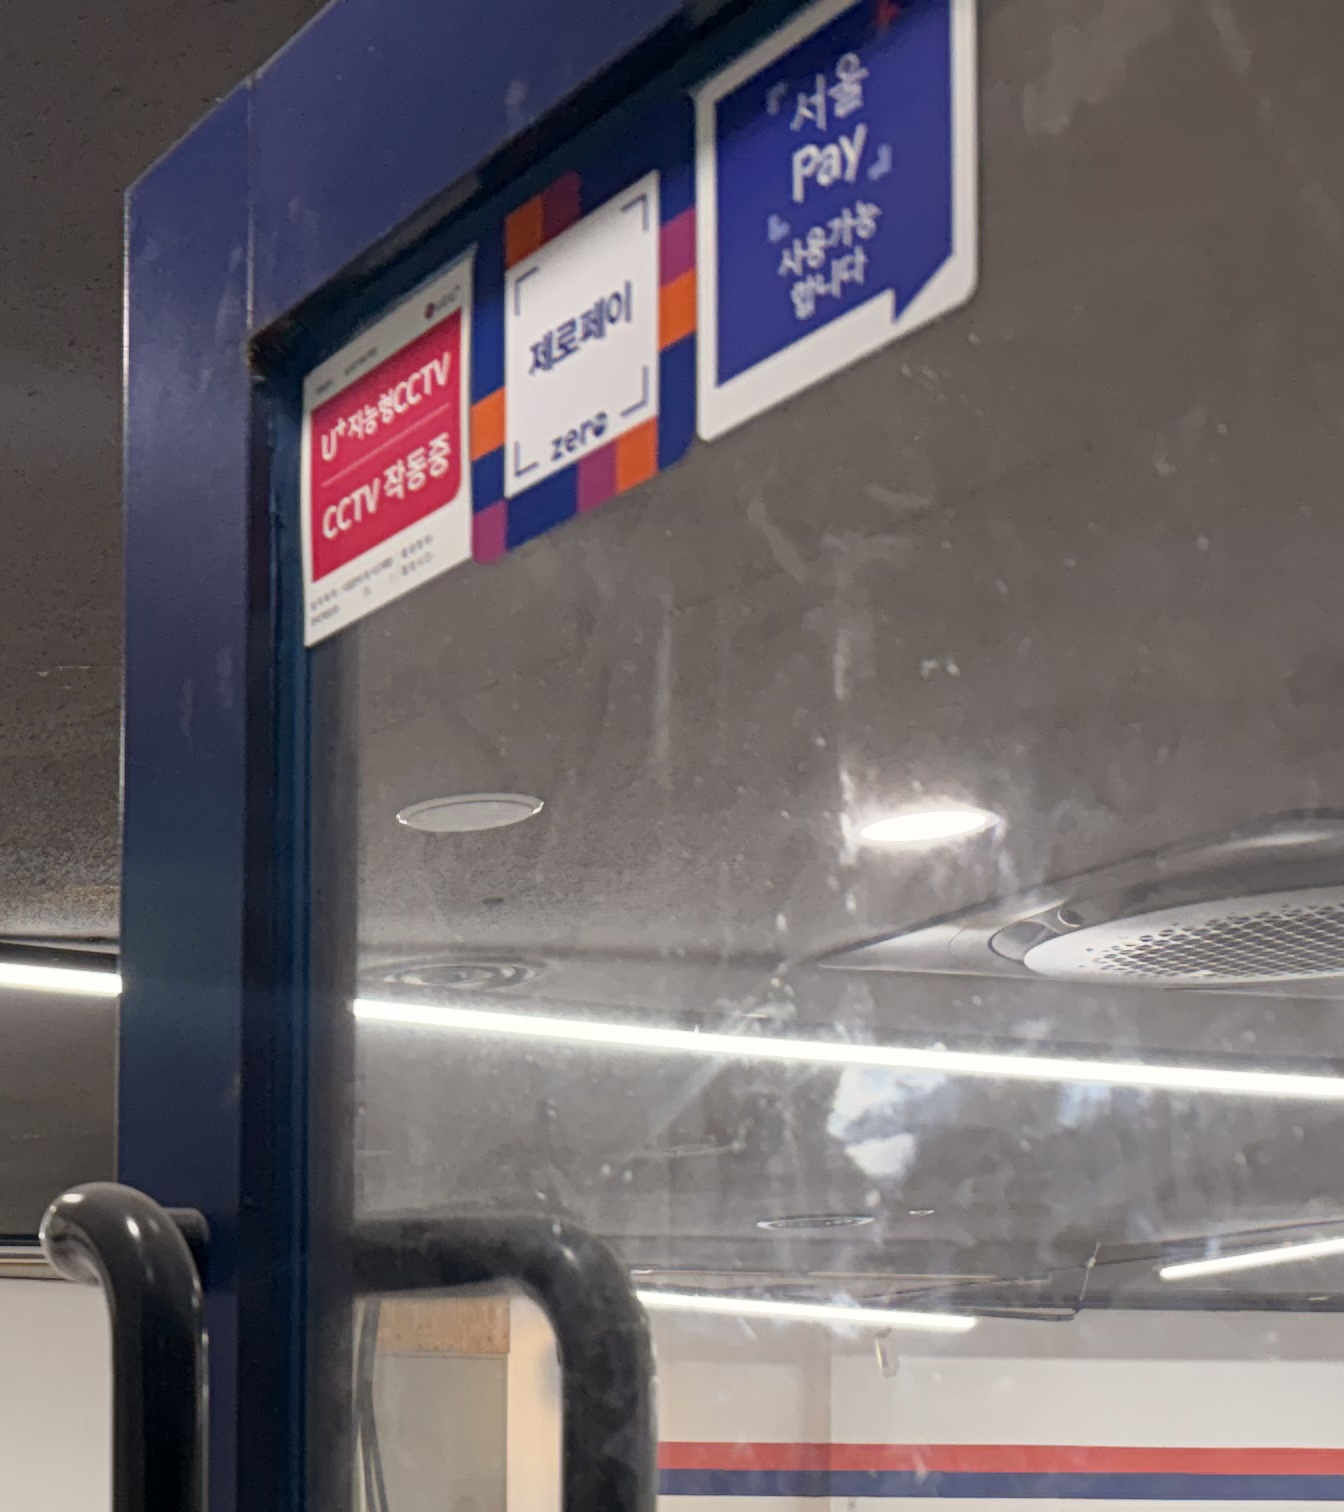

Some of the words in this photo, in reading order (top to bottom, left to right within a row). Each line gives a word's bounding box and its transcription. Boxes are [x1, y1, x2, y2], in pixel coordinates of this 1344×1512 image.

[789, 52, 869, 132] 서울
[789, 245, 868, 320] 합니다
[528, 280, 632, 376] 제로페이
[322, 477, 381, 539] CCTV
[383, 431, 452, 500] 작동중
